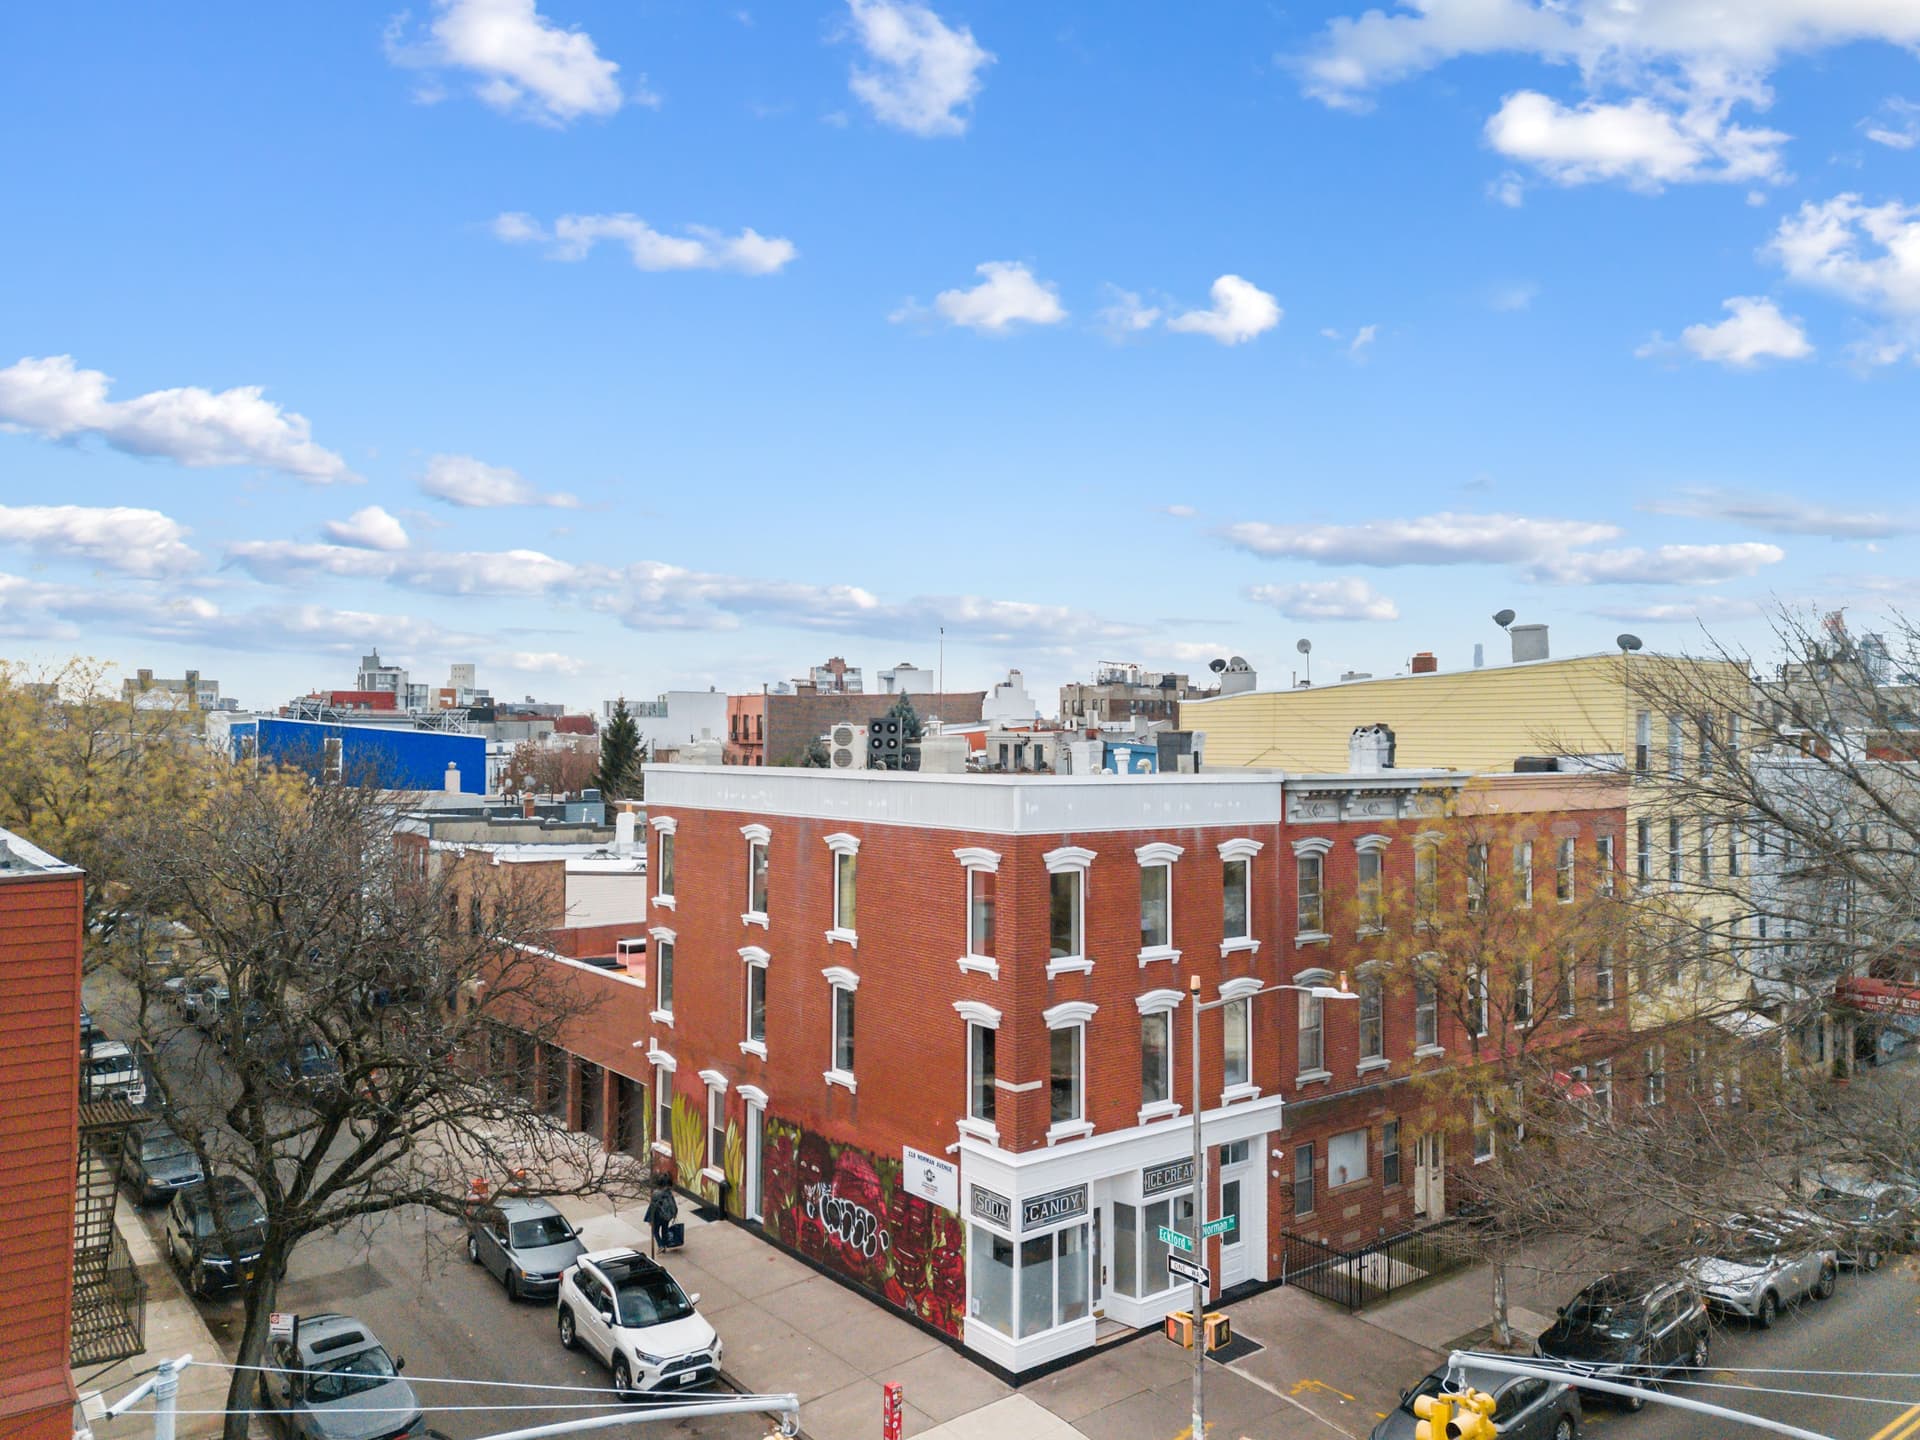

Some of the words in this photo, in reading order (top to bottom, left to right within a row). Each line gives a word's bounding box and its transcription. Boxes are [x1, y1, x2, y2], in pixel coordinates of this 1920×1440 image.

[917, 1154, 935, 1166] NORMAN
[936, 1161, 953, 1173] AVENUE
[1147, 1171, 1163, 1188] ICE
[977, 1195, 1007, 1221] SODA
[1030, 1194, 1080, 1221] CANDY
[1203, 1220, 1228, 1237] Norman
[1159, 1228, 1186, 1249] Eckford
[1174, 1262, 1186, 1273] ONE
[1191, 1269, 1204, 1280] WAY
